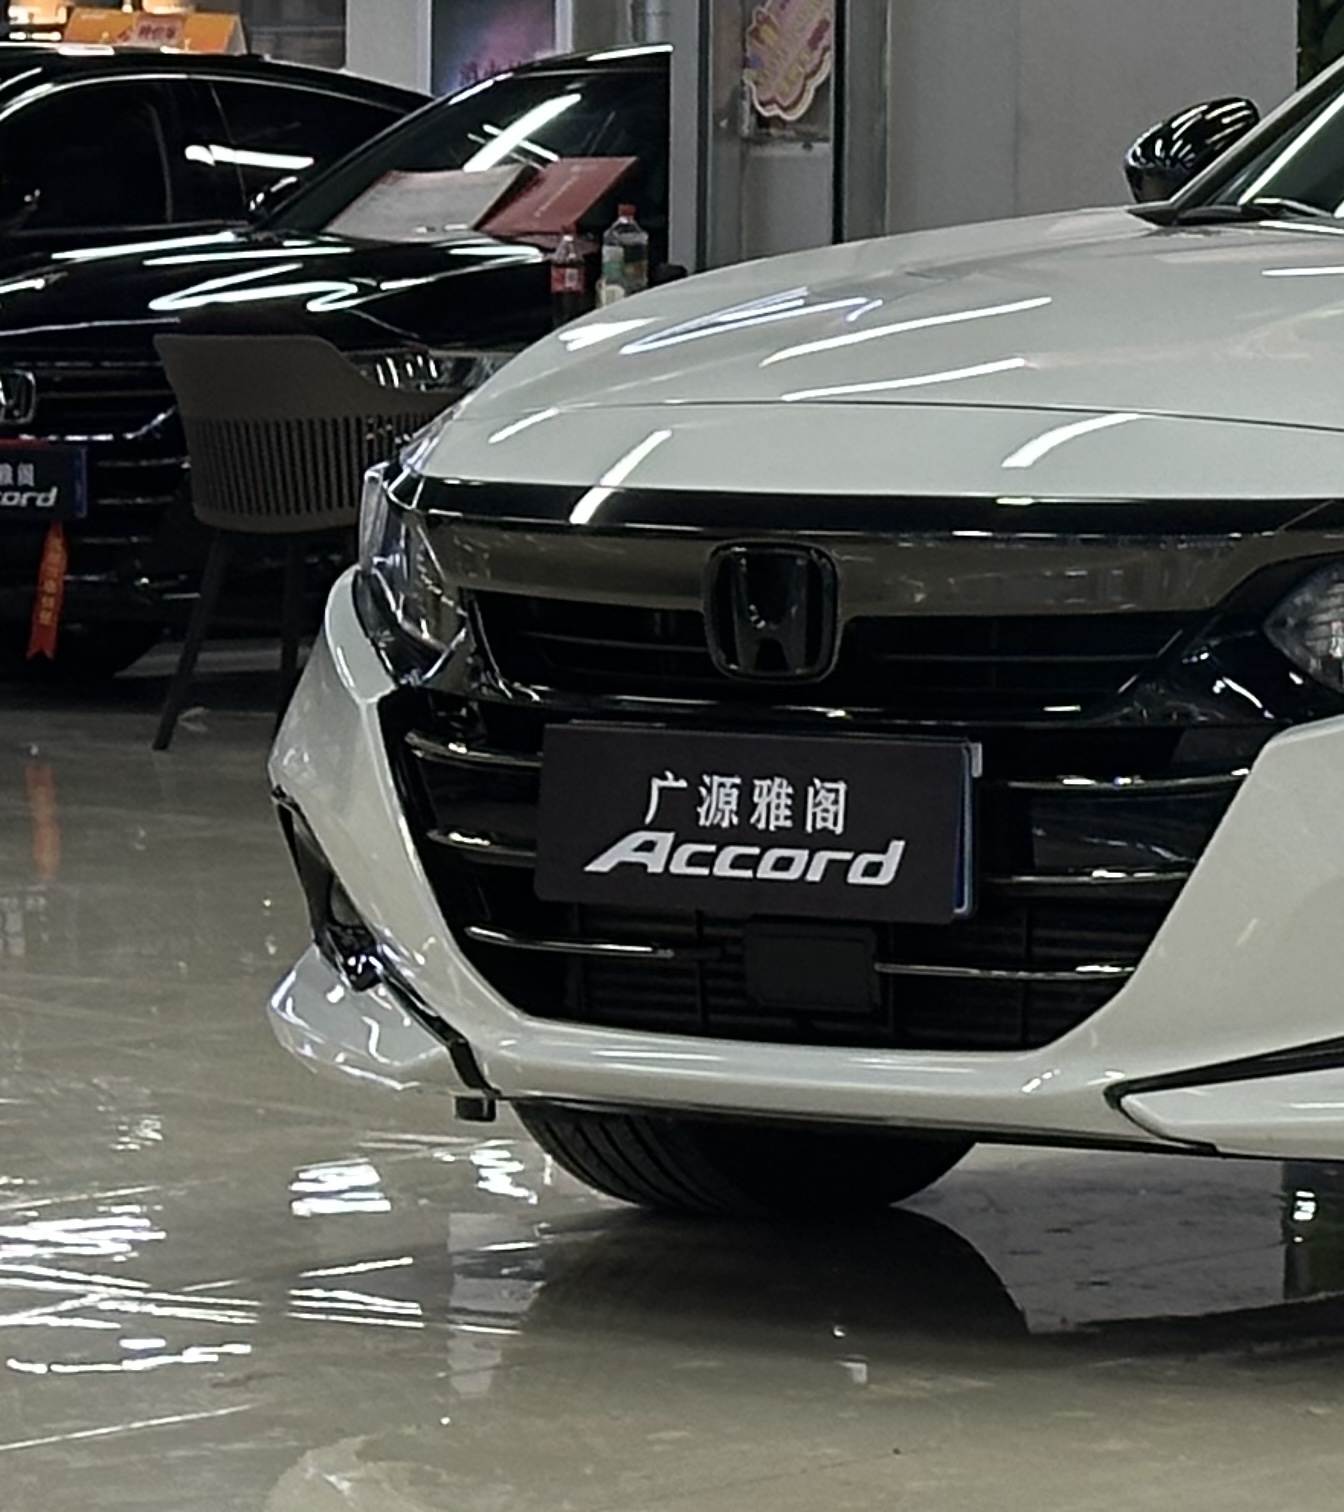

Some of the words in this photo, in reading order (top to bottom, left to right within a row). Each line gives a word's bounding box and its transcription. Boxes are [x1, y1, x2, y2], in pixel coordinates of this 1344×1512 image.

[643, 770, 849, 835] 广源雅阁
[583, 830, 906, 887] Accord
